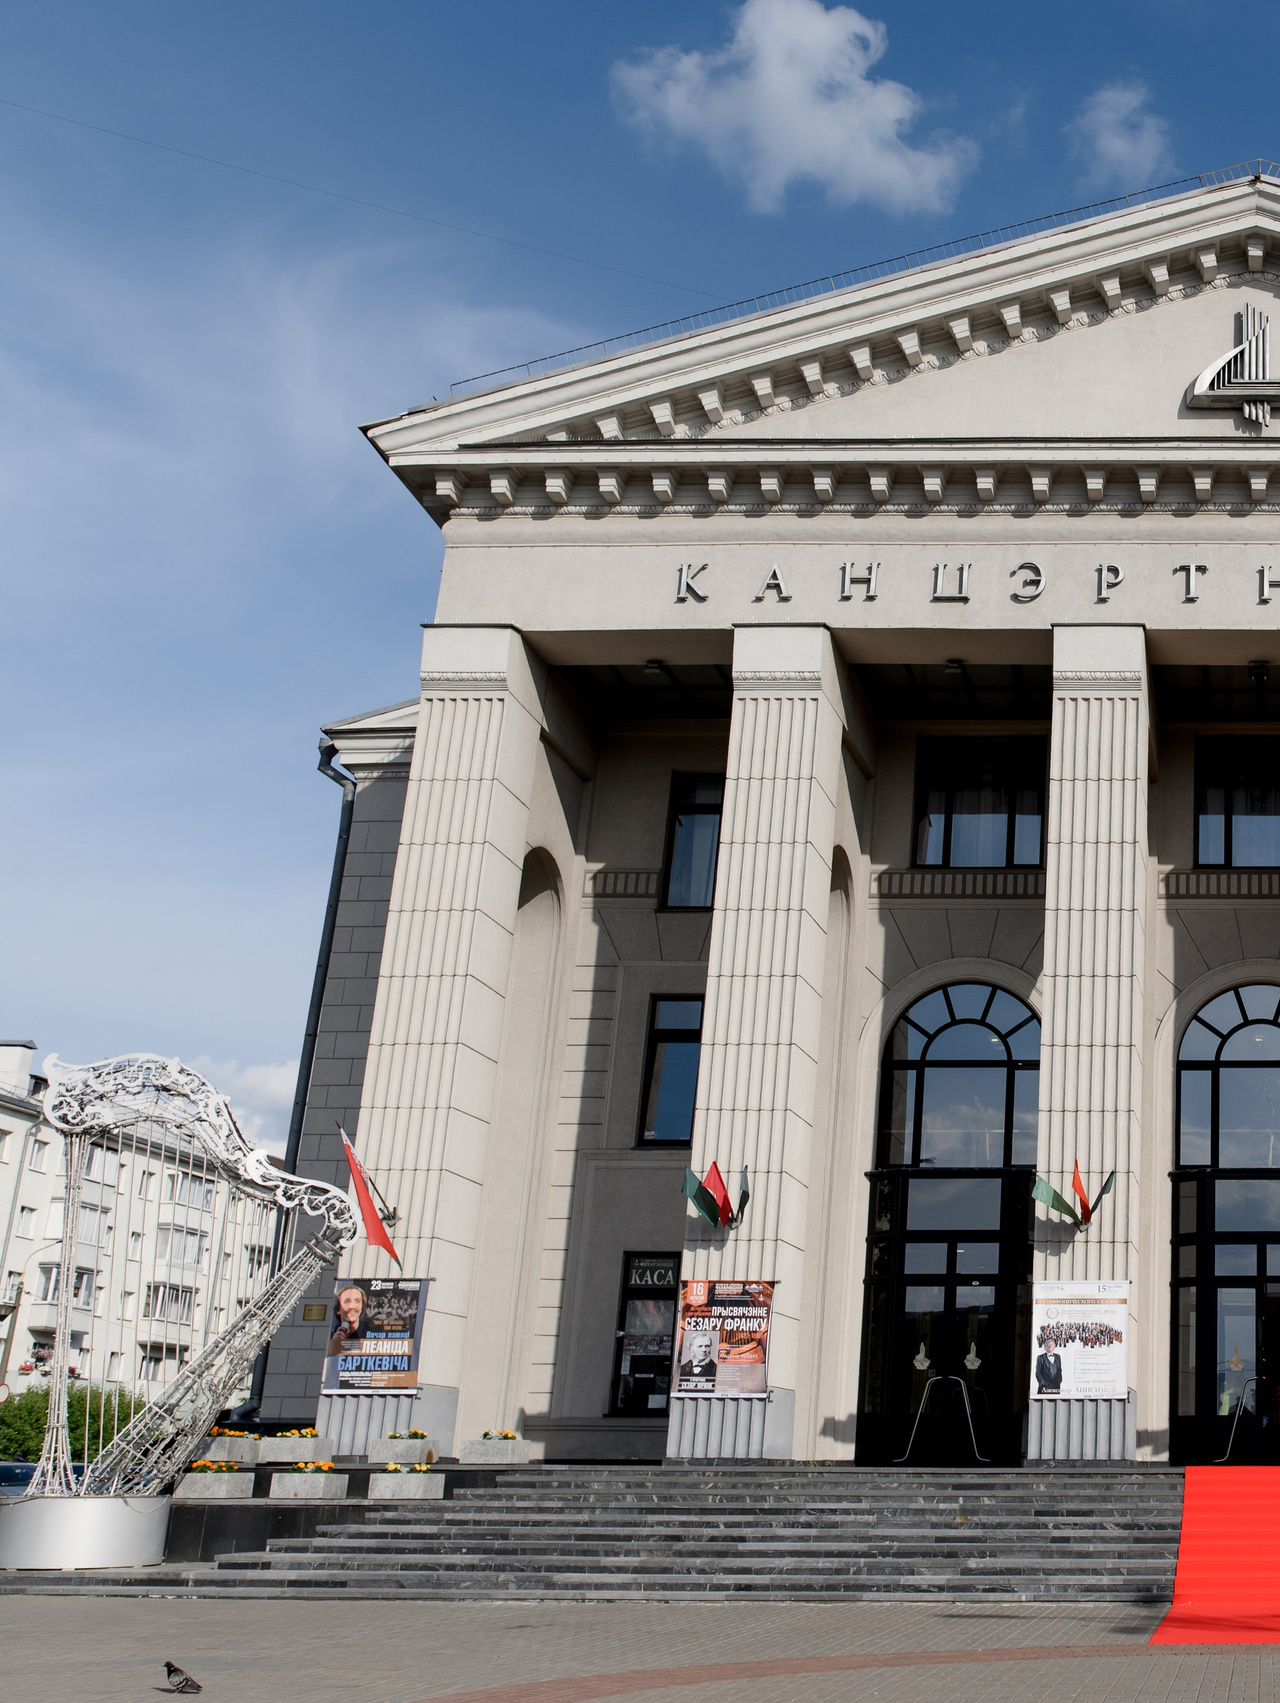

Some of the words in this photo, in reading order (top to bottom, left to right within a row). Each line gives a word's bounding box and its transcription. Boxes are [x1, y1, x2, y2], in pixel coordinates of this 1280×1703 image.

[630, 1269, 675, 1285] КАСА
[371, 1280, 382, 1290] 23
[692, 1282, 704, 1295] 16
[1097, 1285, 1107, 1293] 15
[711, 1306, 768, 1317] ПРЫСВЯЧЭННЕ
[685, 1317, 723, 1331] СЕЗАРУ
[724, 1317, 767, 1331] ФРАНКУ
[366, 1331, 386, 1340] Вечар
[361, 1341, 409, 1355] ЛЕАНІДА
[337, 1355, 409, 1371] БАРТКЕВІЧА
